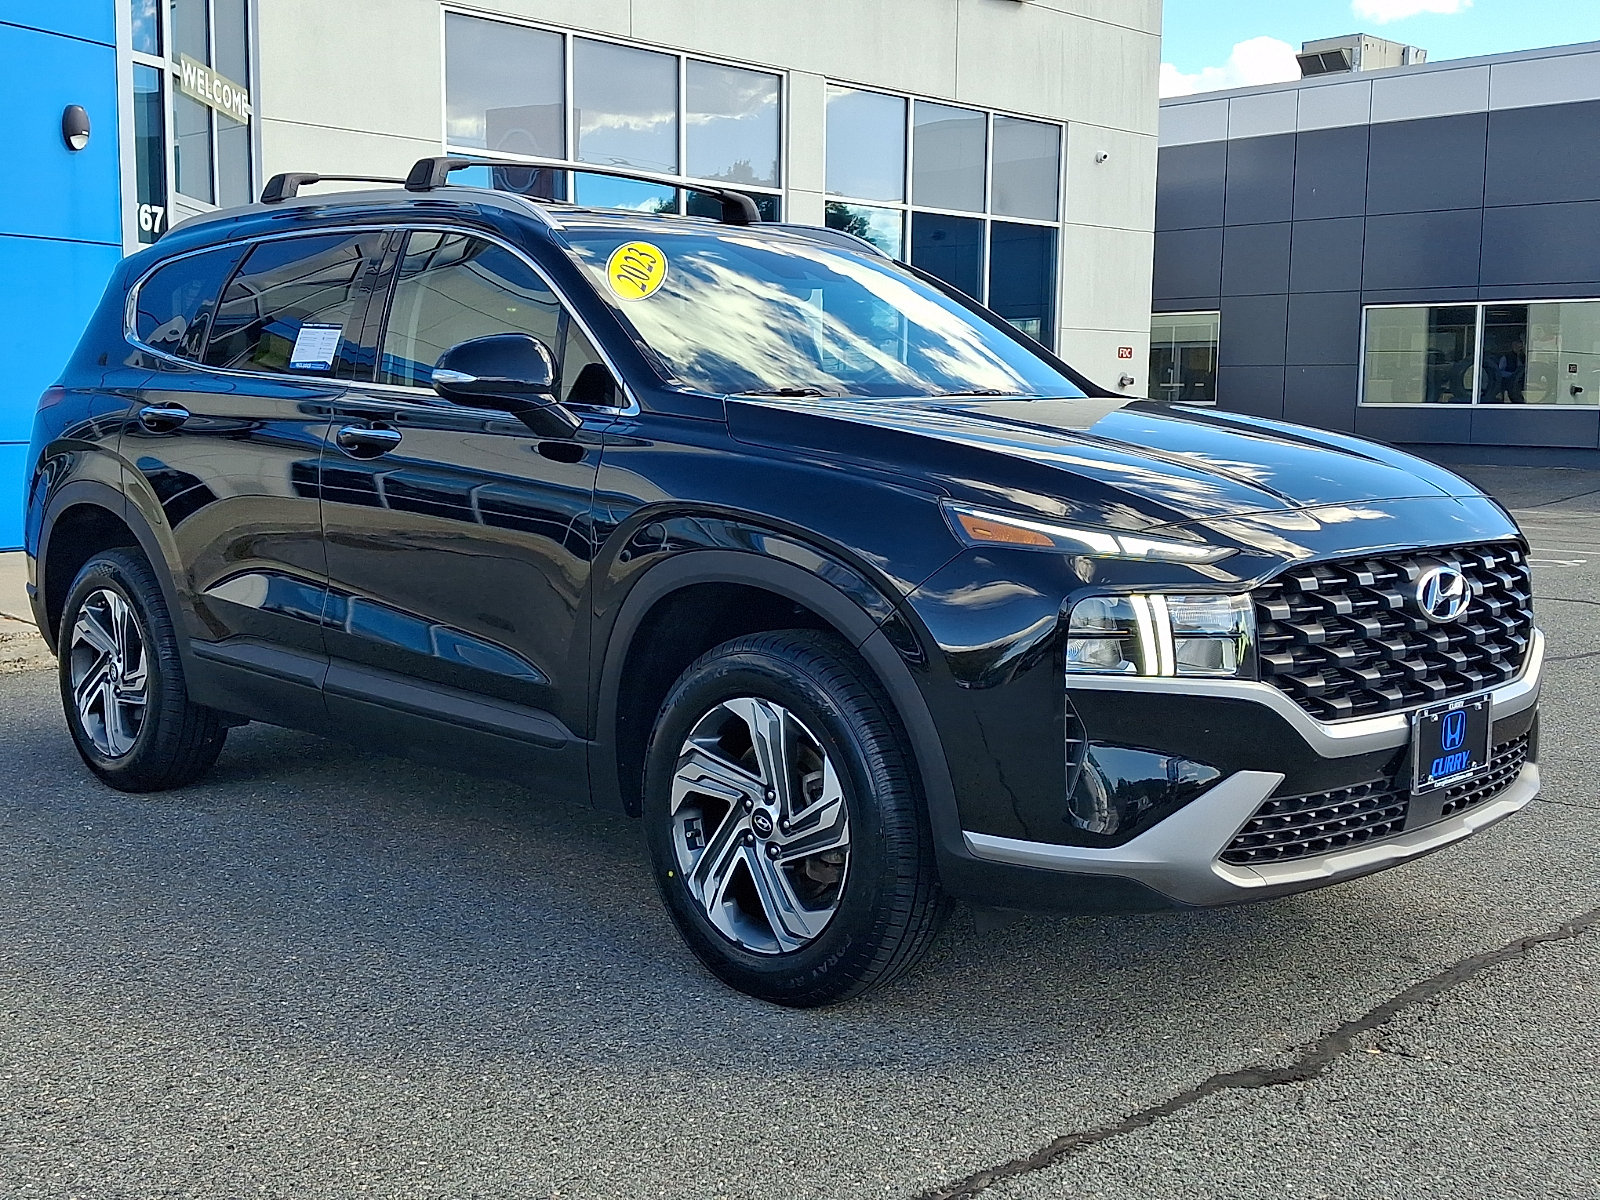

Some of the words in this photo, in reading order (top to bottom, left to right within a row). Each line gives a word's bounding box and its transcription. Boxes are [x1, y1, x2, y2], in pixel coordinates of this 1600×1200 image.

[180, 59, 249, 118] WELCOME
[136, 203, 164, 233] 67
[617, 247, 656, 292] 2023
[1431, 750, 1471, 777] CURRY
